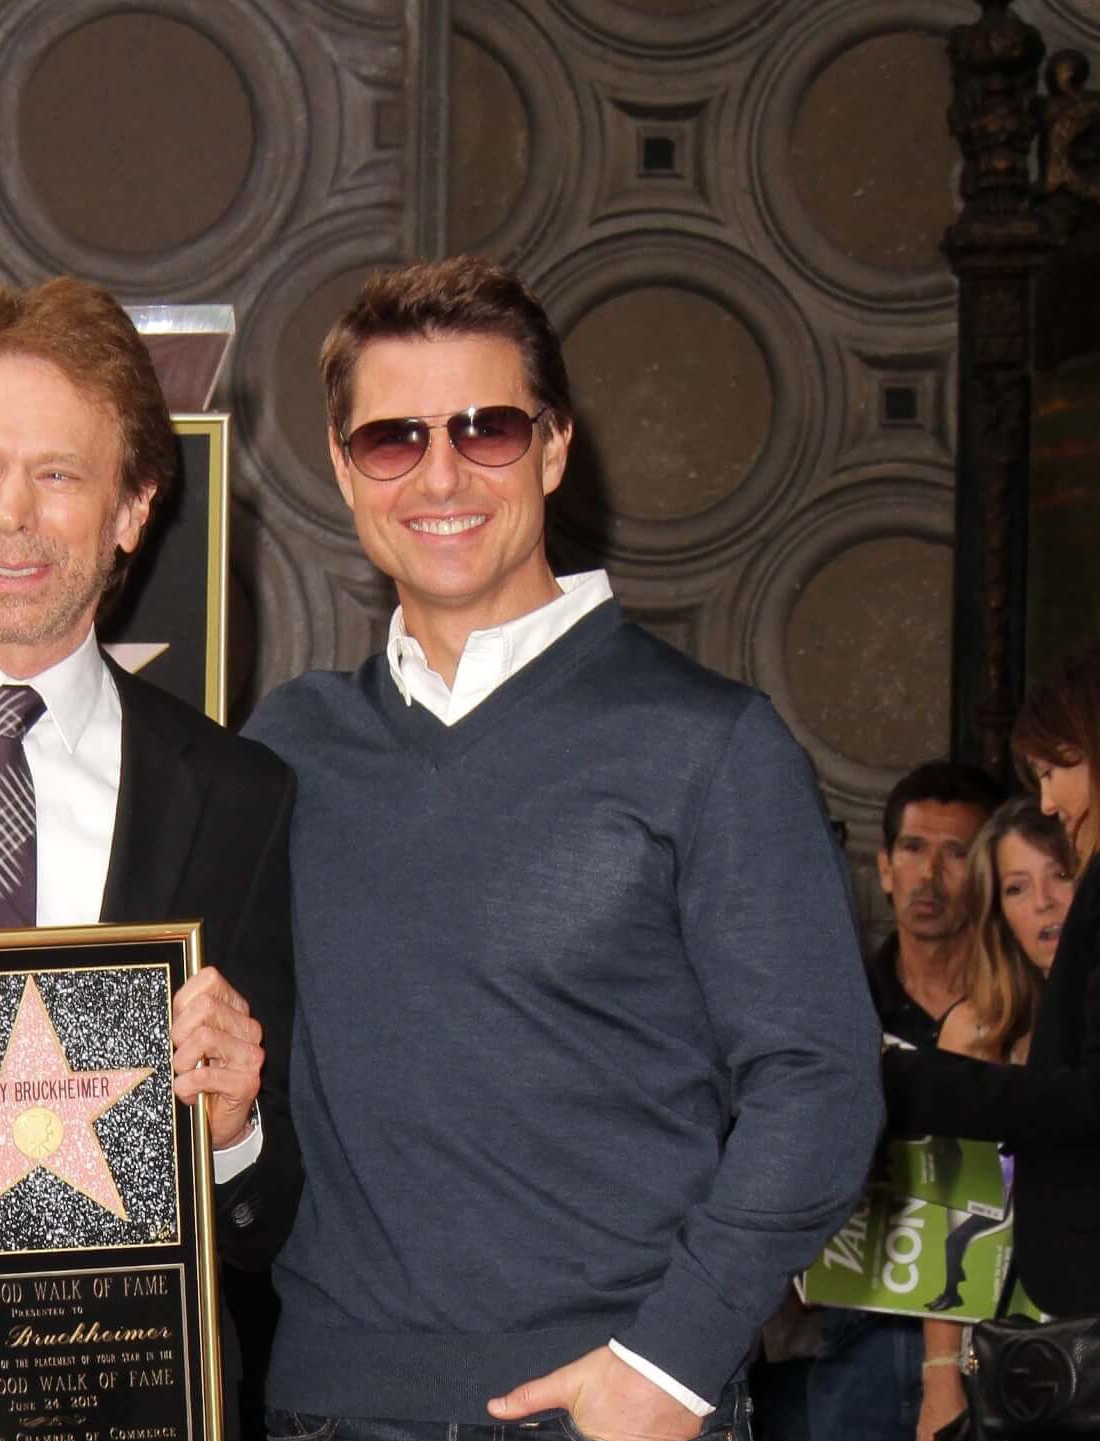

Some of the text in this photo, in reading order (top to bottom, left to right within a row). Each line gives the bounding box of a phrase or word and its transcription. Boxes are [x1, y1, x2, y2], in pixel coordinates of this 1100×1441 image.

[14, 1077, 110, 1102] BRUCKHEIMER
[34, 1279, 82, 1301] WALK
[93, 1277, 113, 1298] OF
[123, 1275, 168, 1297] FAME
[5, 1321, 173, 1348] Bruckheimer
[0, 1359, 9, 1369] OF
[15, 1357, 28, 1368] THE
[34, 1355, 76, 1368] PLACEMENT
[81, 1354, 90, 1365] OF
[97, 1353, 116, 1365] YOUR
[122, 1351, 140, 1363] STAR
[160, 1349, 172, 1360] THE
[40, 1373, 88, 1393] WALK
[99, 1371, 118, 1389] OF
[129, 1368, 174, 1388] FAME
[70, 1395, 98, 1408] 2013
